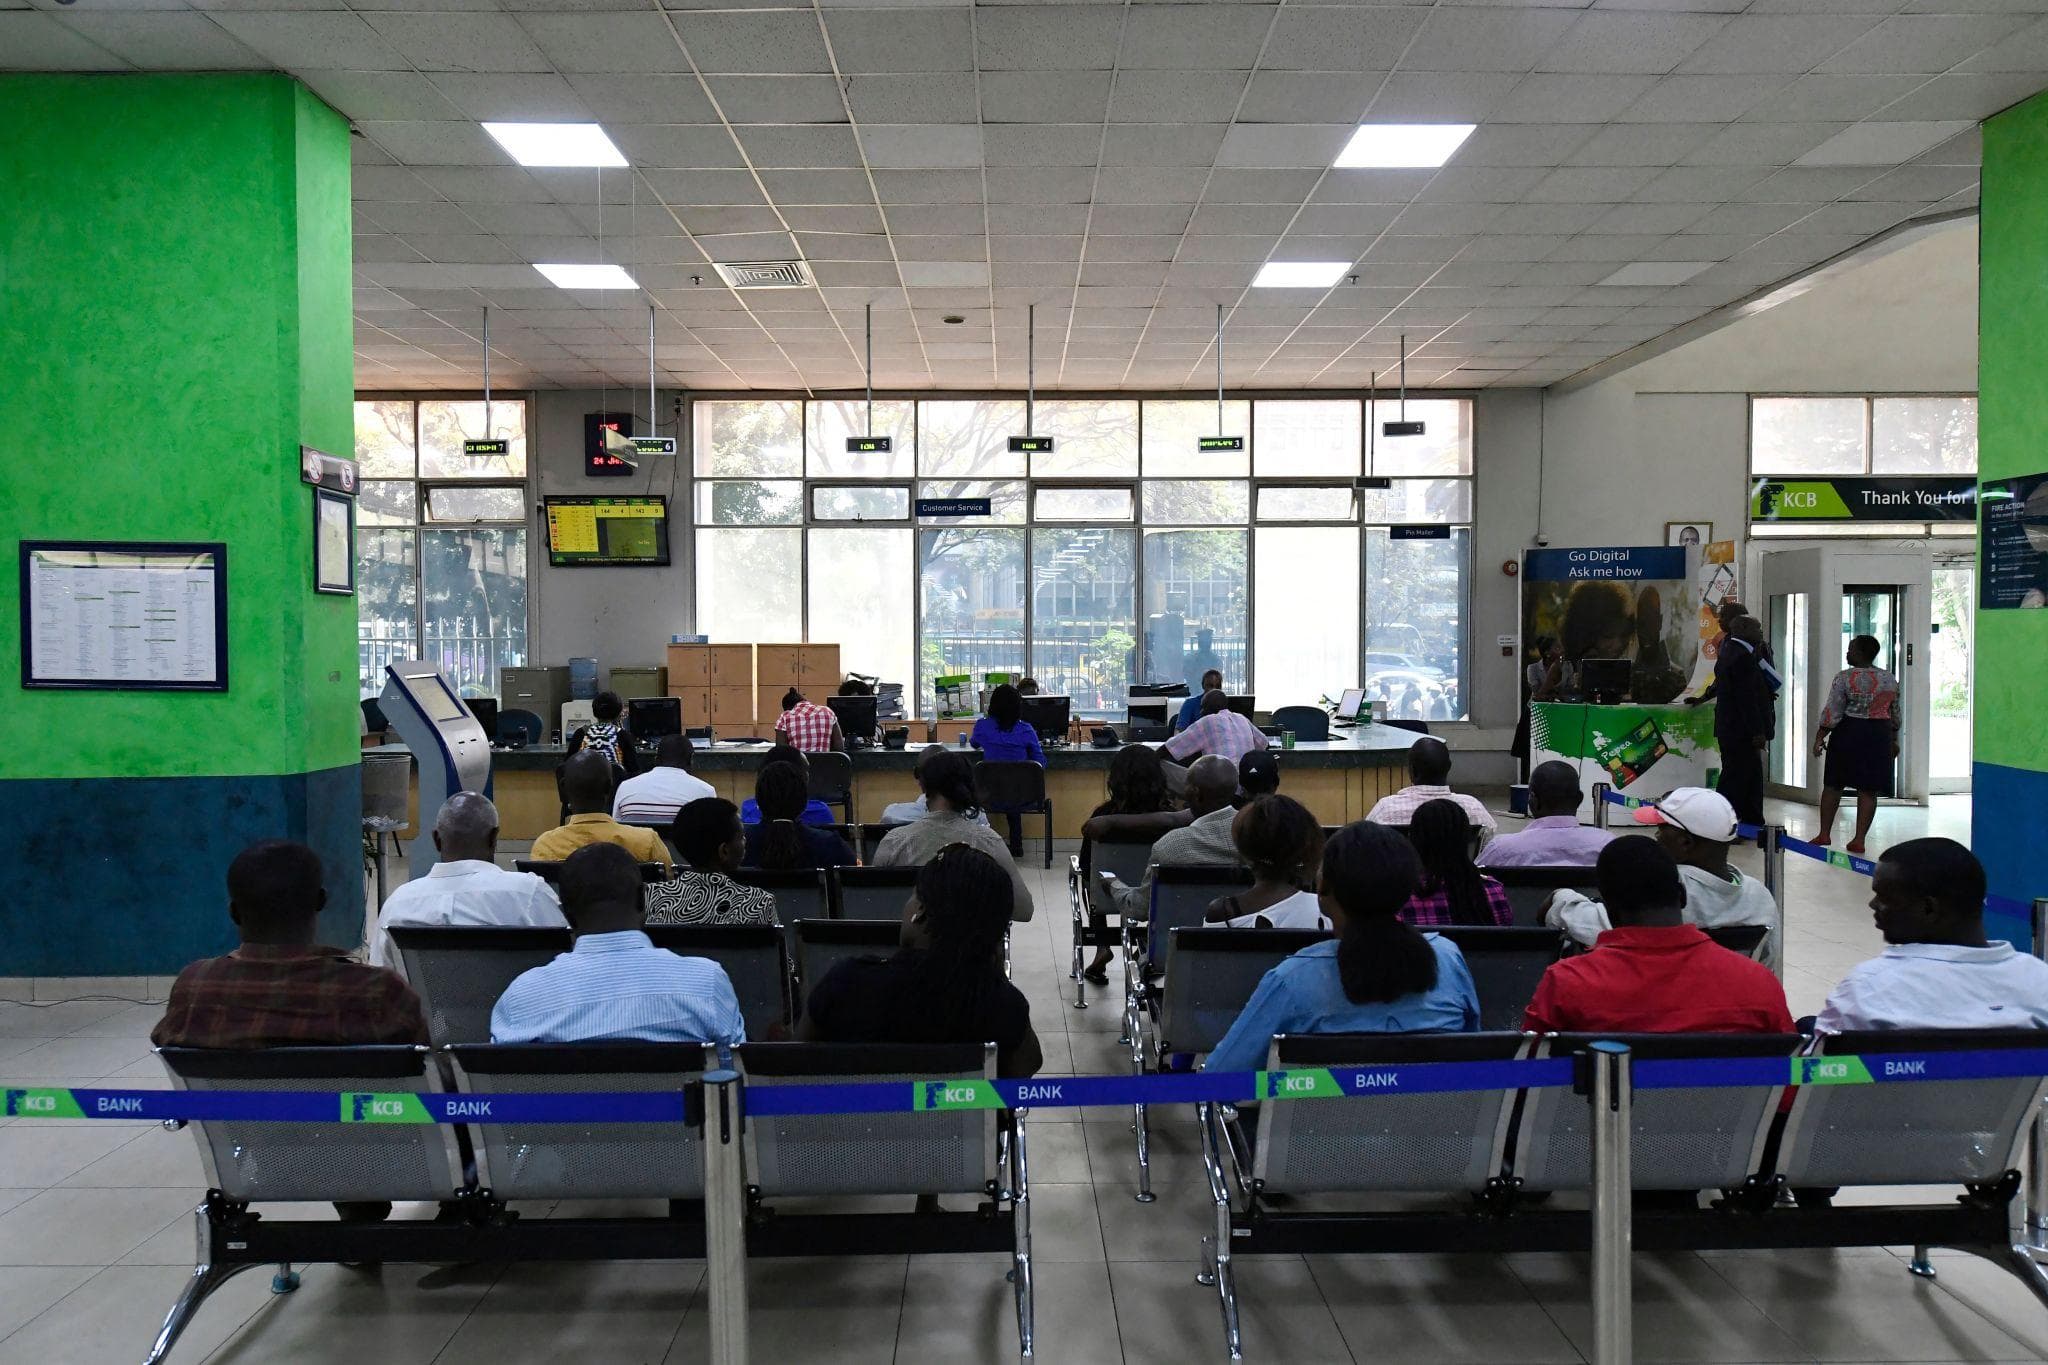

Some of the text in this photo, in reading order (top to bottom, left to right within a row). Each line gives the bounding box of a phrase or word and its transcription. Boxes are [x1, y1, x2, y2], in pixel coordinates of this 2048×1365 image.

[1415, 424, 1421, 432] 2
[498, 443, 504, 452] 7
[664, 442, 671, 451] 6
[881, 440, 887, 449] 5
[1043, 440, 1049, 449] 4
[1234, 439, 1240, 448] 3
[593, 457, 604, 465] 24
[1783, 492, 1817, 507] KCB
[1861, 490, 1911, 505] Thank
[1914, 490, 1941, 505] You
[1942, 490, 1969, 505] for
[922, 503, 983, 512] Customer Service
[2005, 502, 2025, 510] ACTION
[1568, 549, 1630, 564] Go Digital
[1568, 566, 1643, 577] Ask me how
[1601, 740, 1632, 761] Pepea
[1855, 861, 1870, 872] BANK
[1819, 1061, 1925, 1077] KCB BANK
[1285, 1072, 1398, 1091] KCB BANK
[944, 1085, 1062, 1103] KCB BANK
[24, 1096, 143, 1112] KCB BANK
[371, 1100, 492, 1117] KCB BANK
